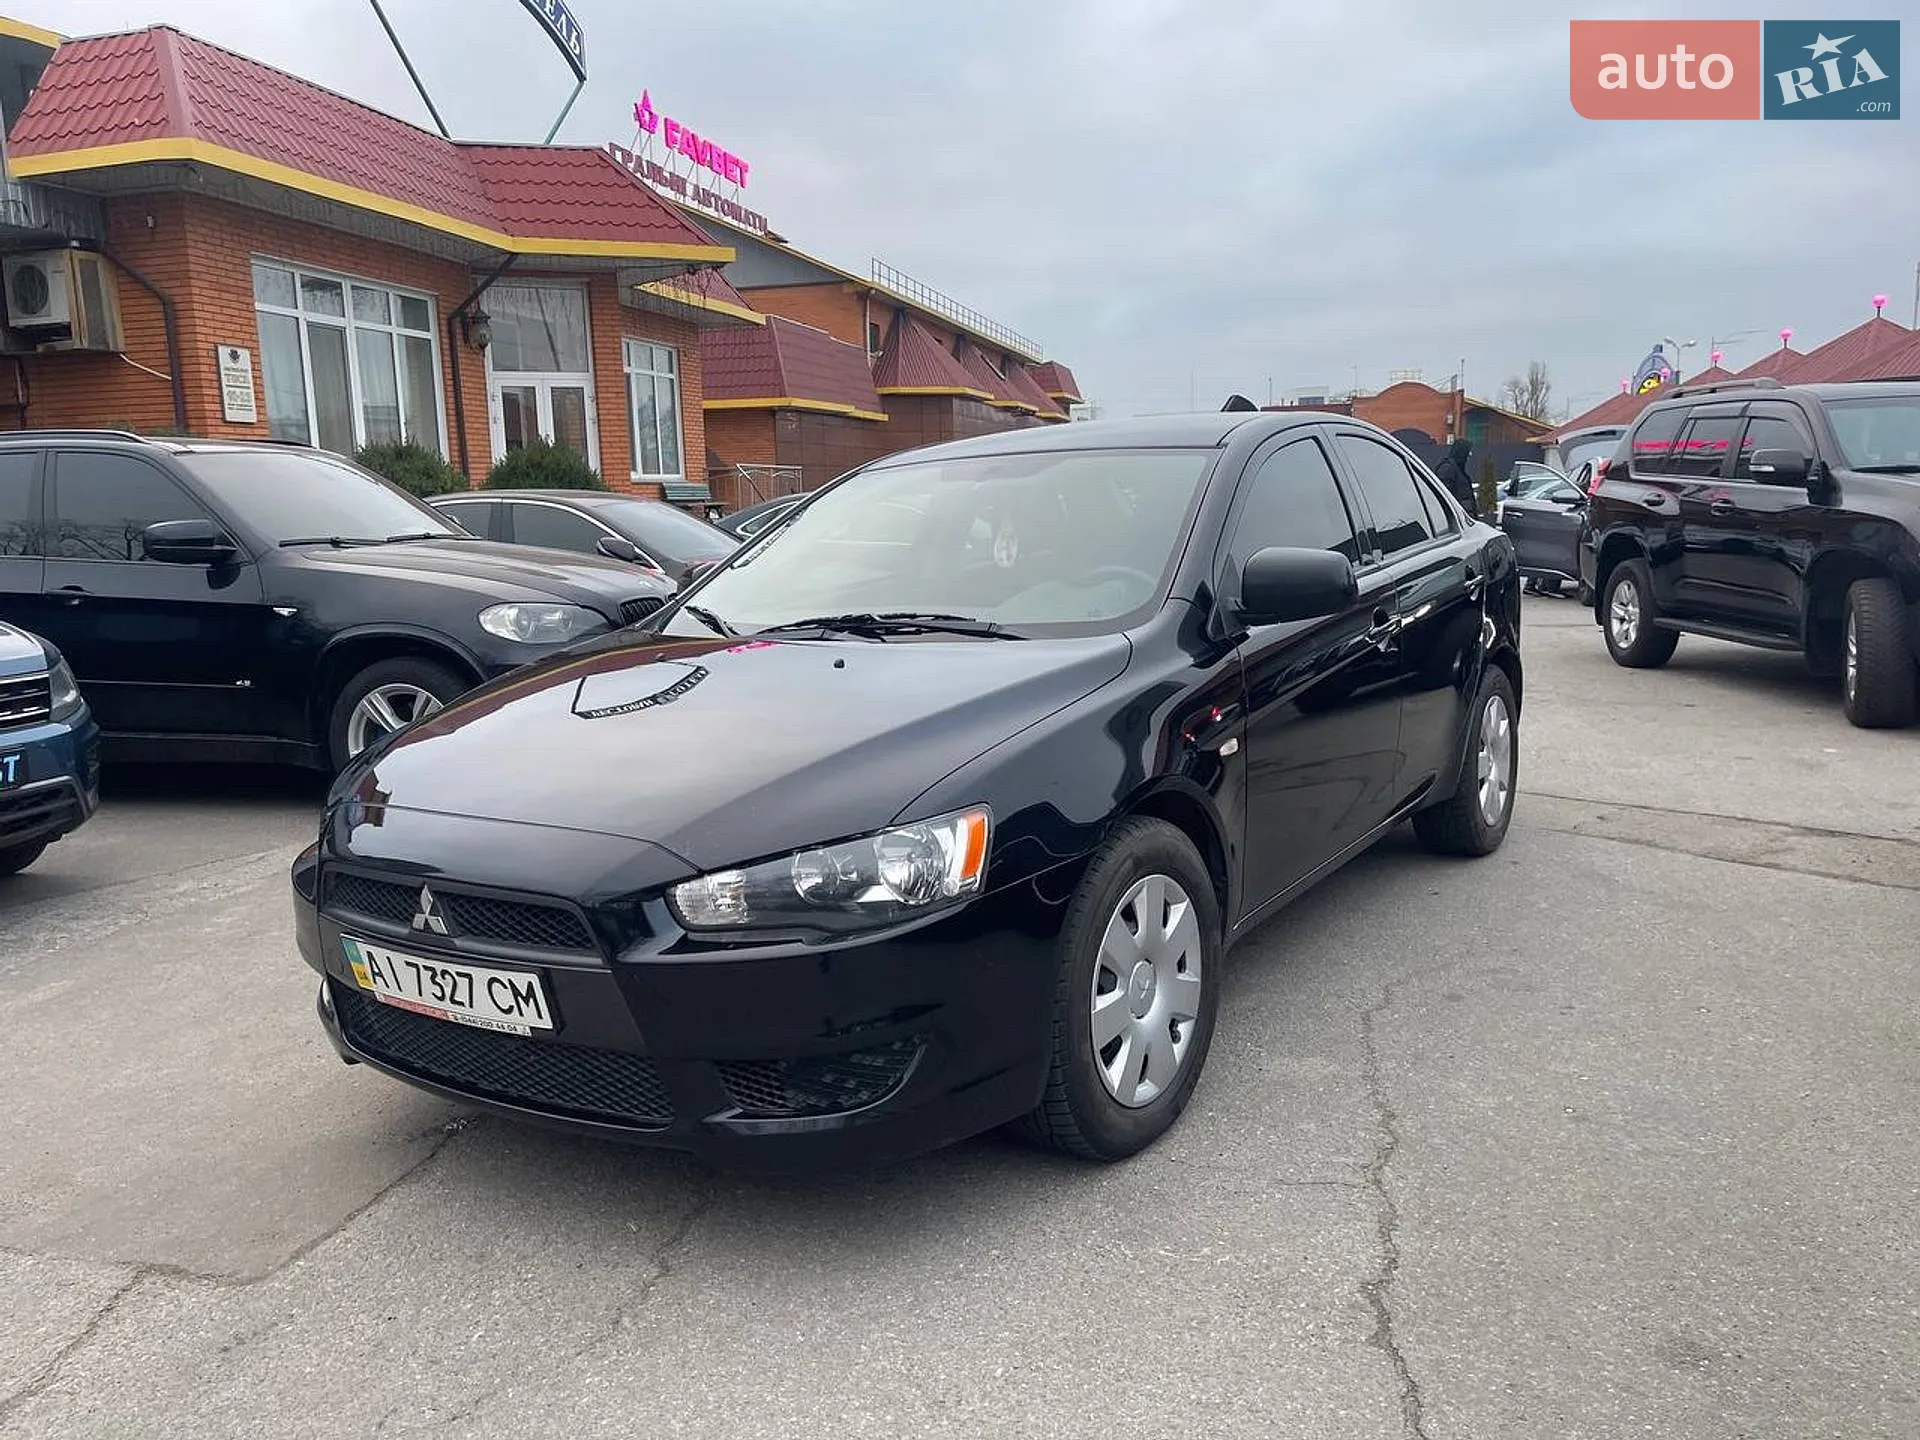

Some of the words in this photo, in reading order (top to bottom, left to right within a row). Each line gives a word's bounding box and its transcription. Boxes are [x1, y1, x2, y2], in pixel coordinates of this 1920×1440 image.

[535, 0, 581, 55] ЕЛЬ
[664, 117, 749, 189] FAVBET
[692, 184, 768, 237] АВТОМАТИ
[366, 951, 402, 993] AI
[404, 959, 474, 1009] 7327
[487, 976, 544, 1020] CM
